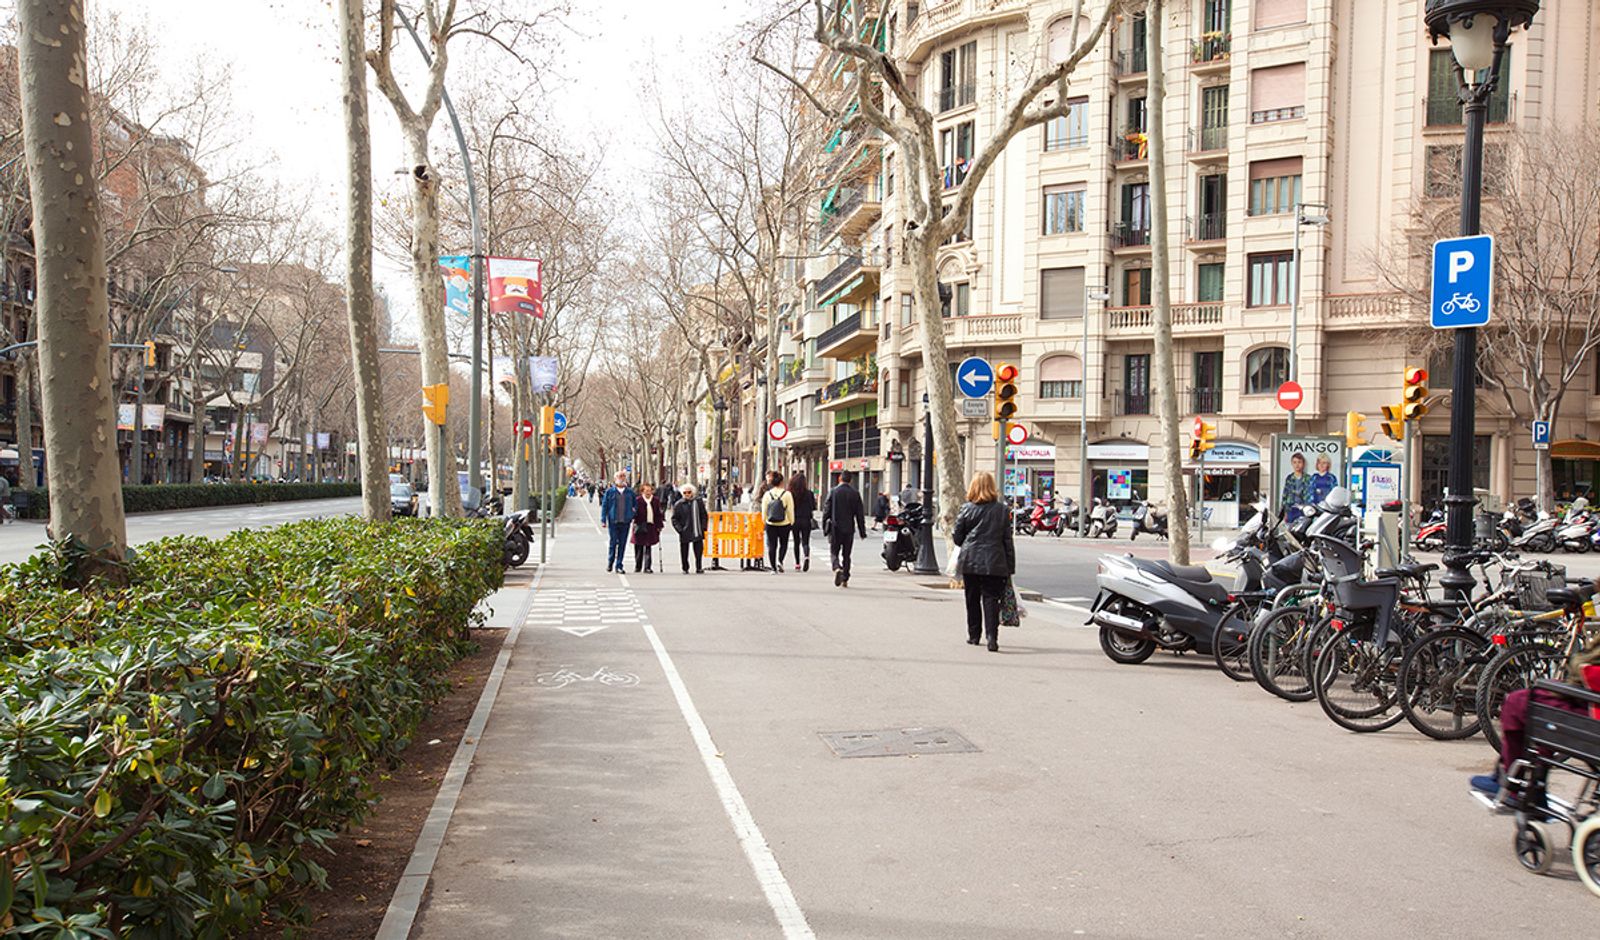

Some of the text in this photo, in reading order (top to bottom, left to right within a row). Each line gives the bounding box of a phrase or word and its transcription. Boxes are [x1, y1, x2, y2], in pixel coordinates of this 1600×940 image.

[1448, 250, 1475, 284] P
[1537, 424, 1547, 441] P
[1281, 442, 1339, 453] MANGO
